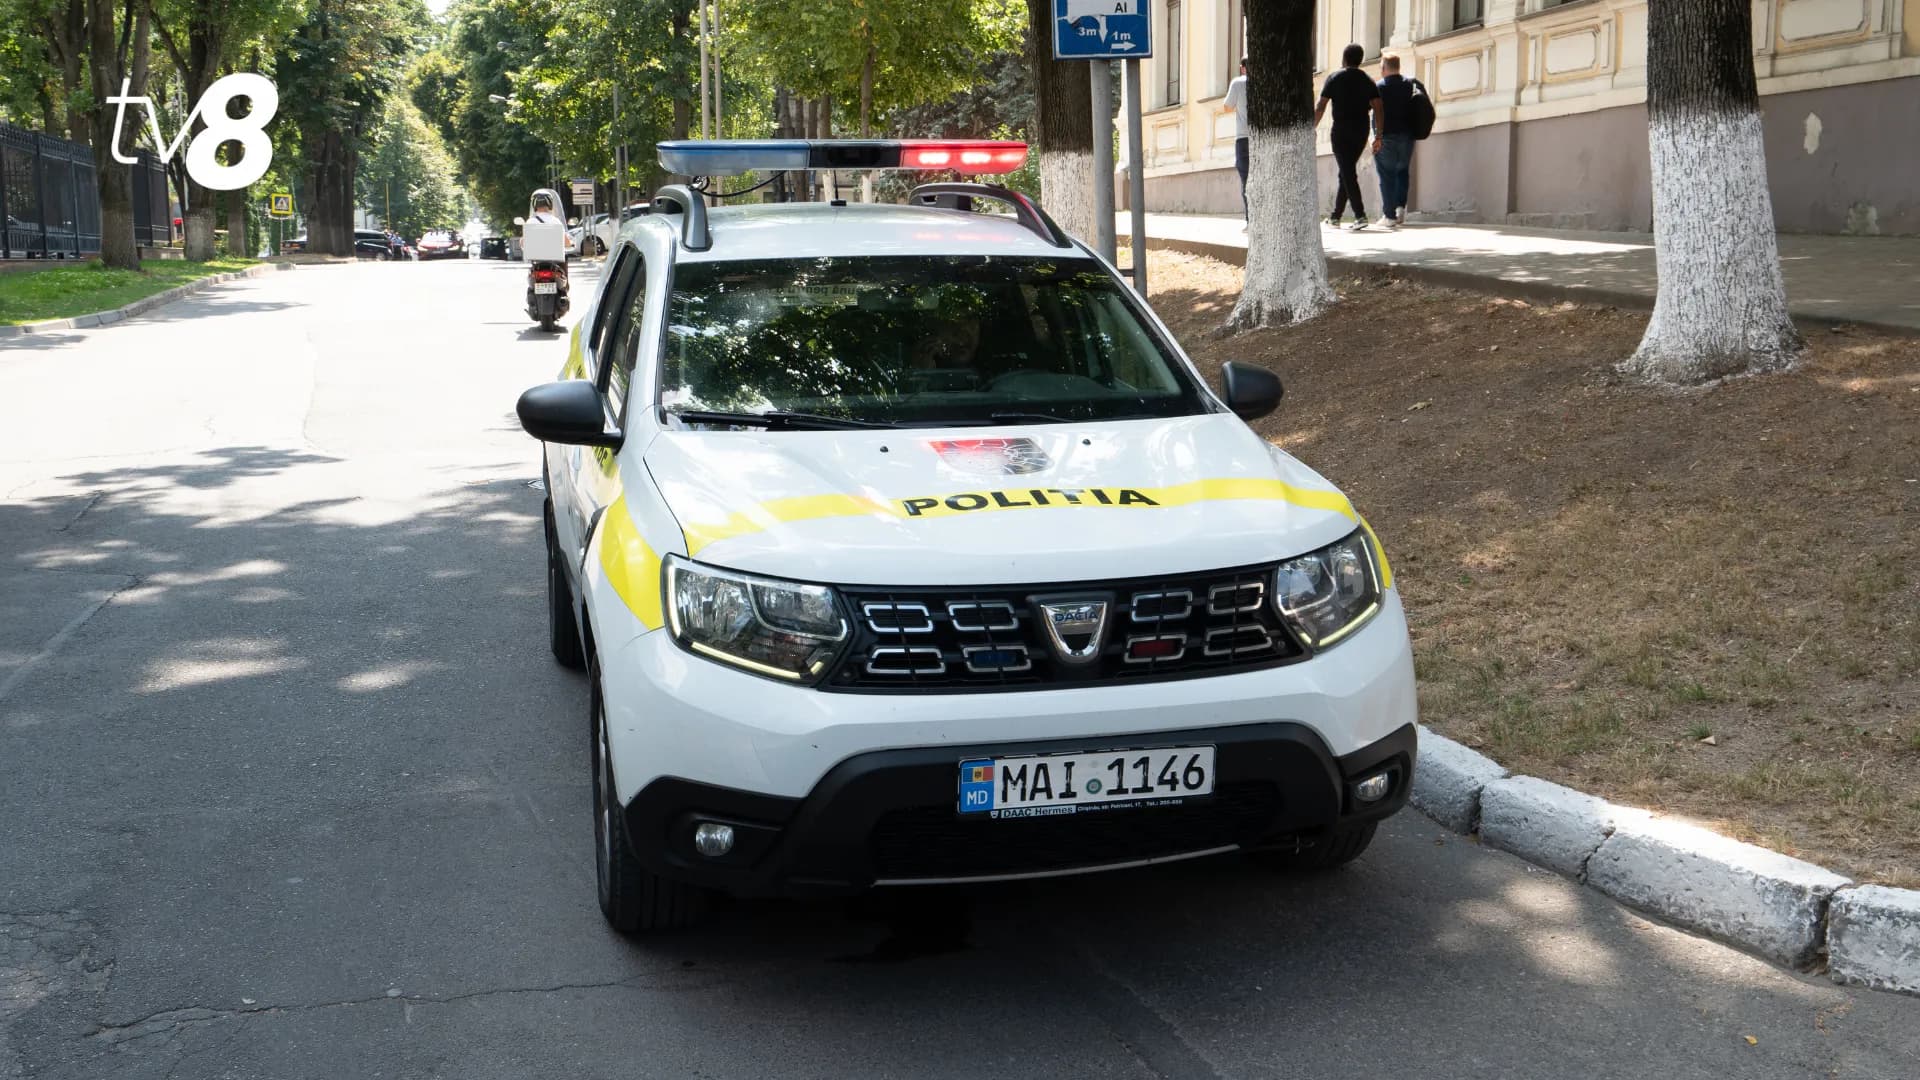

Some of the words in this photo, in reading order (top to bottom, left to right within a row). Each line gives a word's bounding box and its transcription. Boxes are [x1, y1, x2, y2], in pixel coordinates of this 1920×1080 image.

[1054, 611, 1098, 622] DACIA
[1001, 760, 1077, 804] MAI
[1106, 753, 1205, 796] 1146
[966, 789, 988, 806] MD
[1003, 808, 1032, 818] DAAC
[1035, 805, 1073, 816] Hermes
